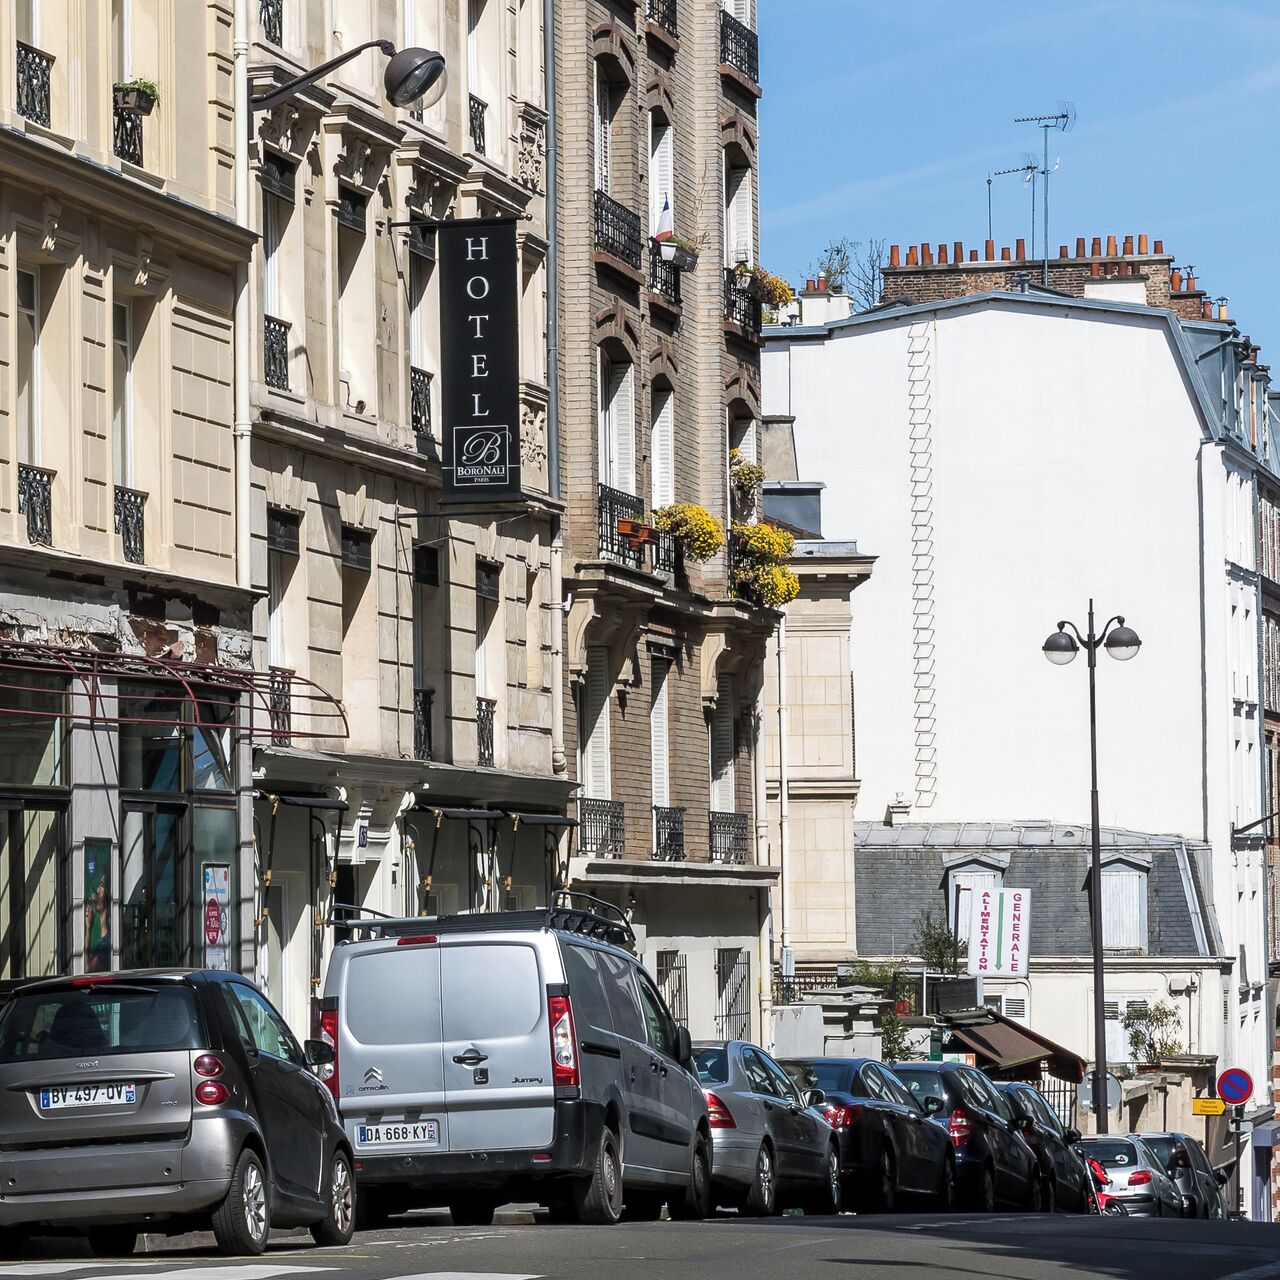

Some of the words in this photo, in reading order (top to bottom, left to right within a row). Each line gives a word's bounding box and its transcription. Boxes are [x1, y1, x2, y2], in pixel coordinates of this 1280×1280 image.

[465, 237, 490, 417] HOTEL
[978, 891, 991, 971] ALIMENTATION
[1010, 893, 1022, 972] GENERALE
[51, 1083, 123, 1104] BV-497-QV
[125, 1092, 135, 1100] 75
[366, 1125, 427, 1142] DA-668-KY
